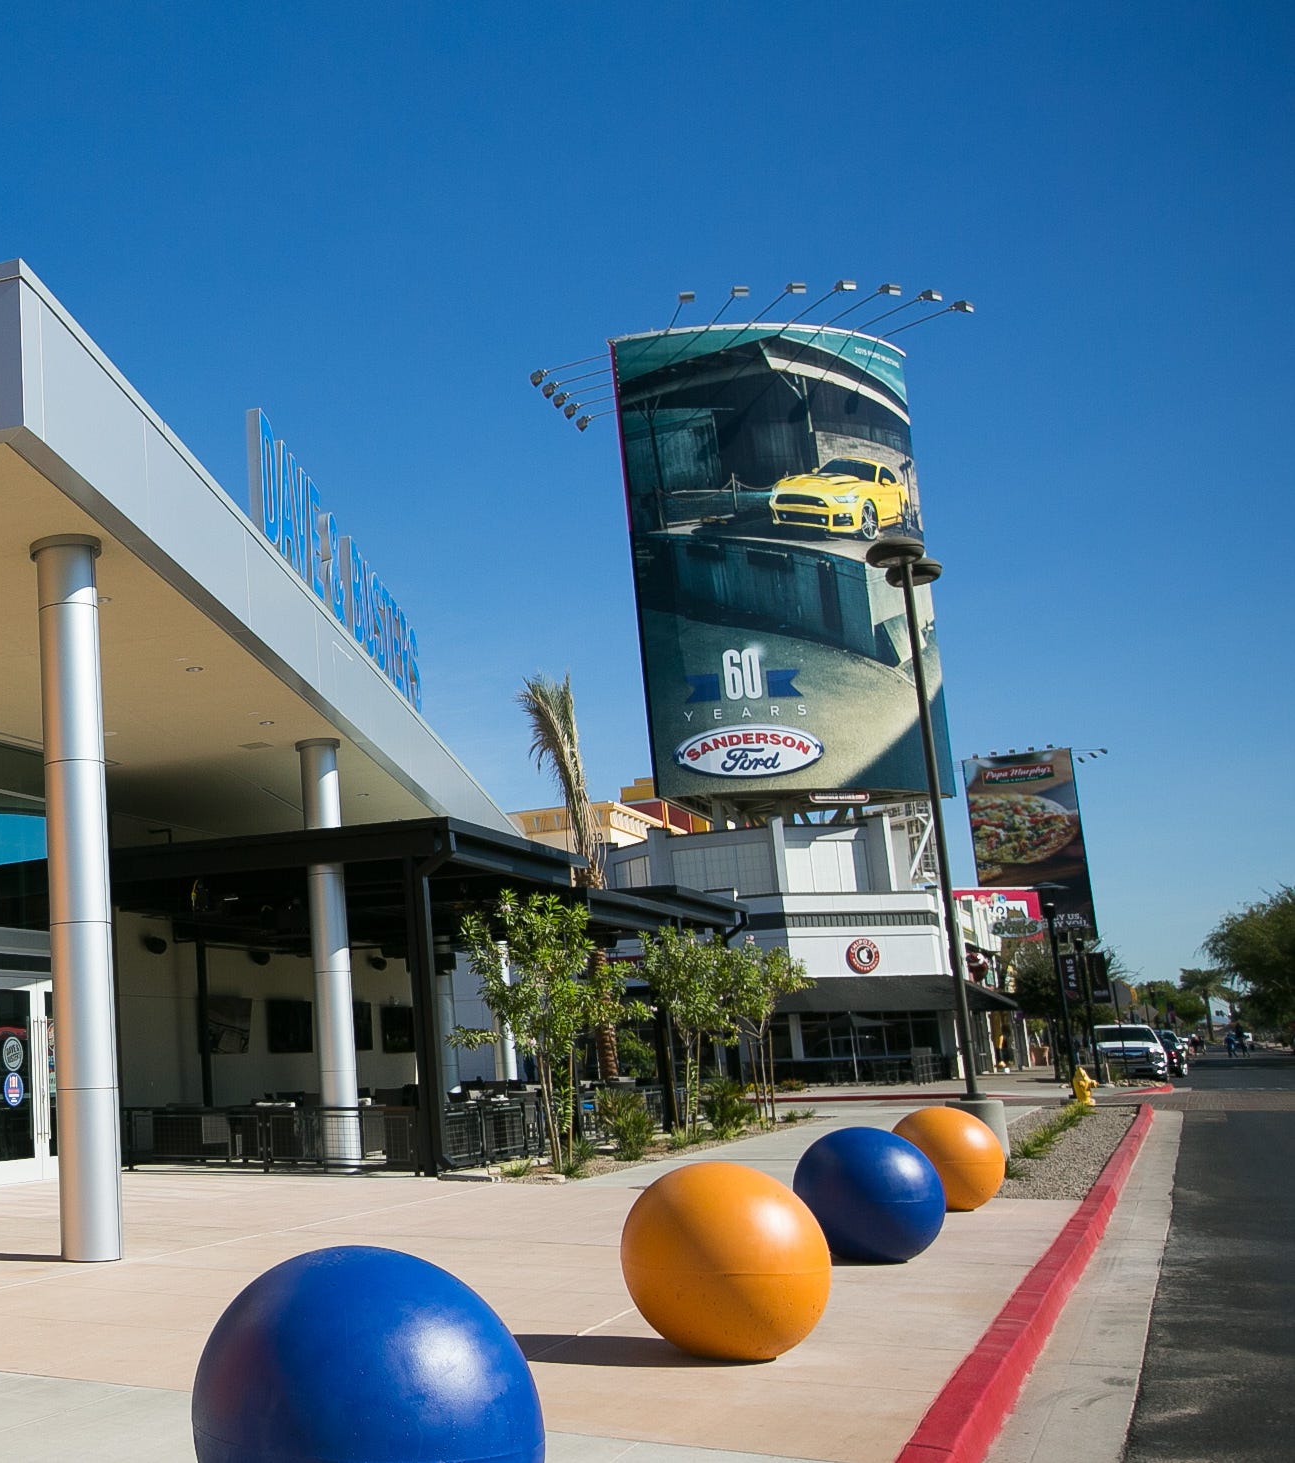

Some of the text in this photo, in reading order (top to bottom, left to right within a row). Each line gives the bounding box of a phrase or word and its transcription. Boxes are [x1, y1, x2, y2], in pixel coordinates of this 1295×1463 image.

[250, 407, 324, 602] DAVE
[322, 511, 345, 629] &
[722, 647, 763, 700] 60
[683, 704, 807, 722] YEARS
[686, 732, 811, 762] SANDERSON
[721, 747, 781, 773] Ford
[986, 770, 1008, 780] Papa
[1066, 959, 1077, 987] FANS
